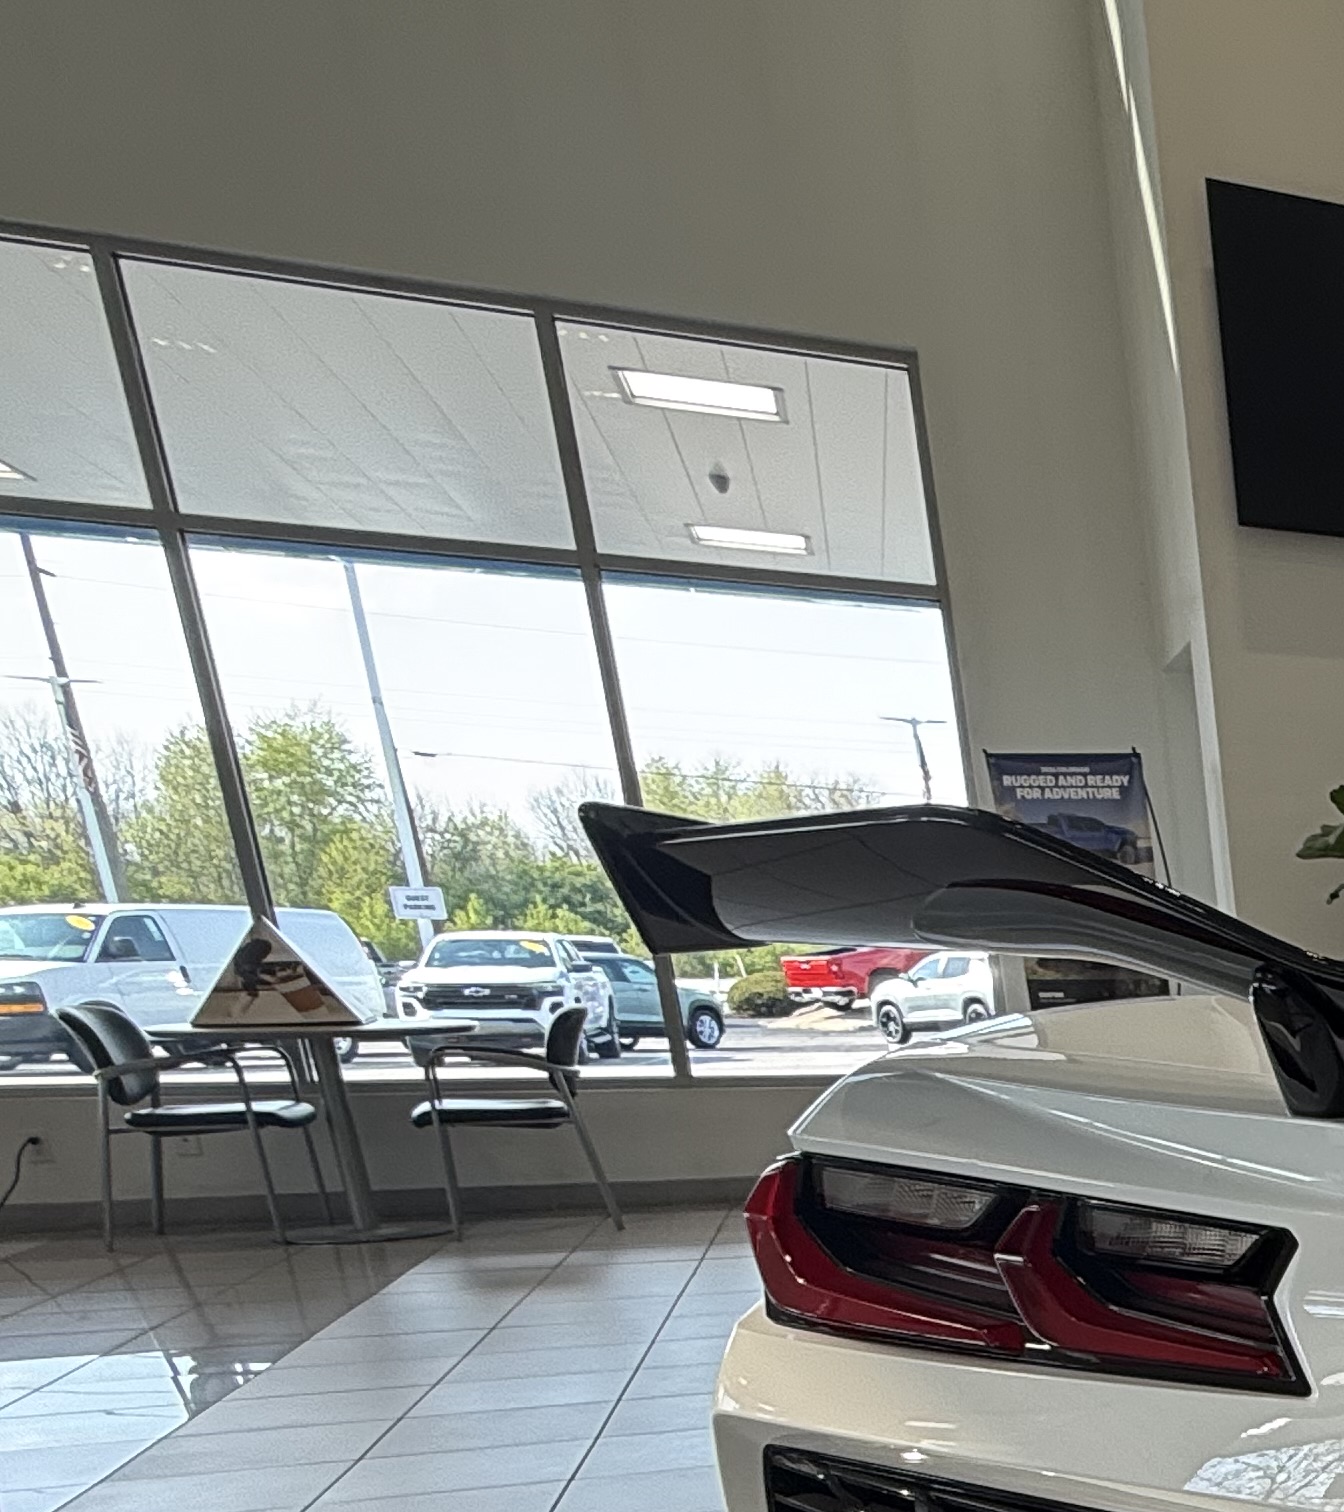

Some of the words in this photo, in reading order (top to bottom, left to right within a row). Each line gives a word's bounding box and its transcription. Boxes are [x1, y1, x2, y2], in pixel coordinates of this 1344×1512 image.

[1003, 775, 1055, 786] RUGGED
[1058, 775, 1085, 786] AND
[1087, 775, 1129, 786] READY
[1016, 788, 1042, 799] FOR
[1044, 788, 1120, 799] ADVENTURE
